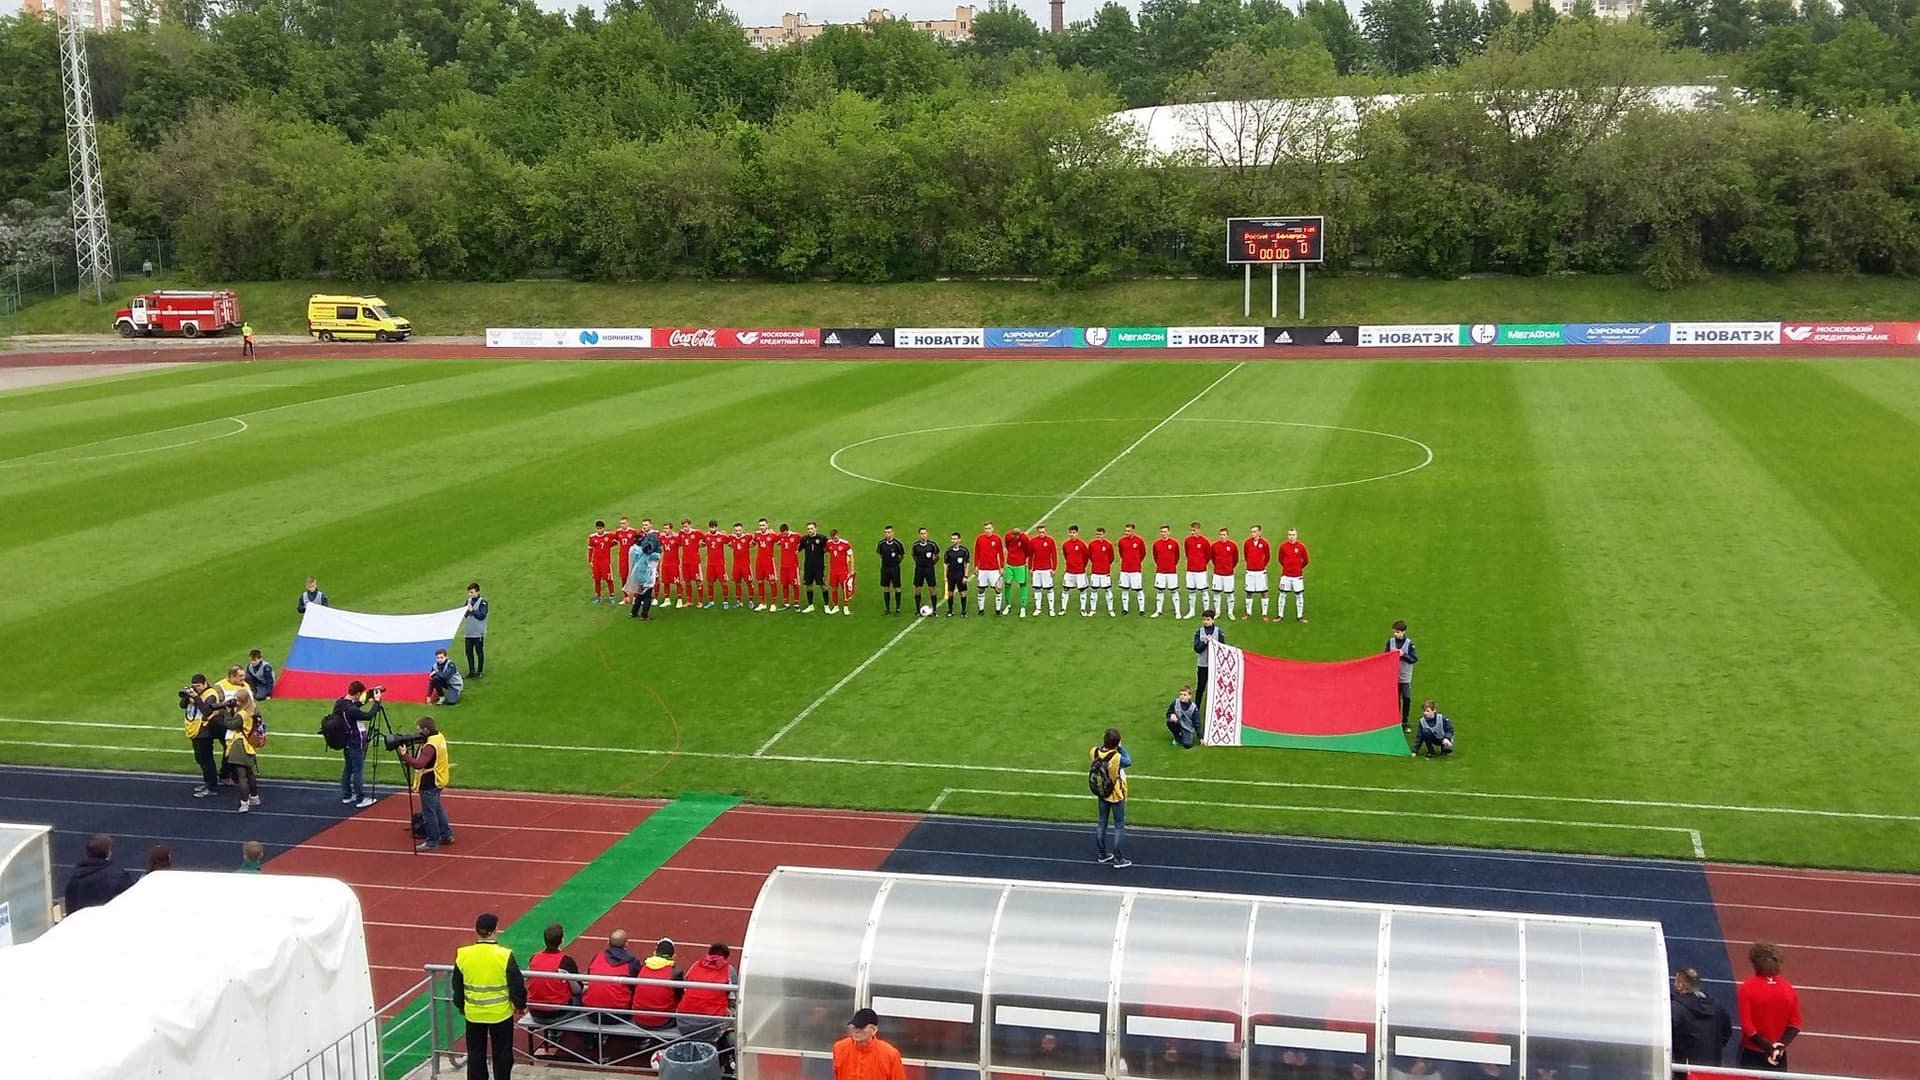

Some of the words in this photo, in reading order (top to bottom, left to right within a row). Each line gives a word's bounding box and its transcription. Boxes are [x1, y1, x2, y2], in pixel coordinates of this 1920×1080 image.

[1248, 243, 1256, 255] 0
[1300, 242, 1308, 254] 0
[1586, 327, 1641, 335] АЭРОФЛОТ
[1816, 324, 1874, 333] МОСКОВСКИЙ
[761, 330, 804, 338] МОСКОВСКИЙ
[1378, 333, 1454, 344] НОВАТЭК
[1694, 330, 1775, 341] НОВАТЭК
[1814, 333, 1865, 341] КРЕДИТНЫЙ
[760, 337, 798, 345] КРЕДИТНЫЙ
[914, 335, 980, 345] НОВАТЭК
[1188, 334, 1259, 345] НОВАТЭК
